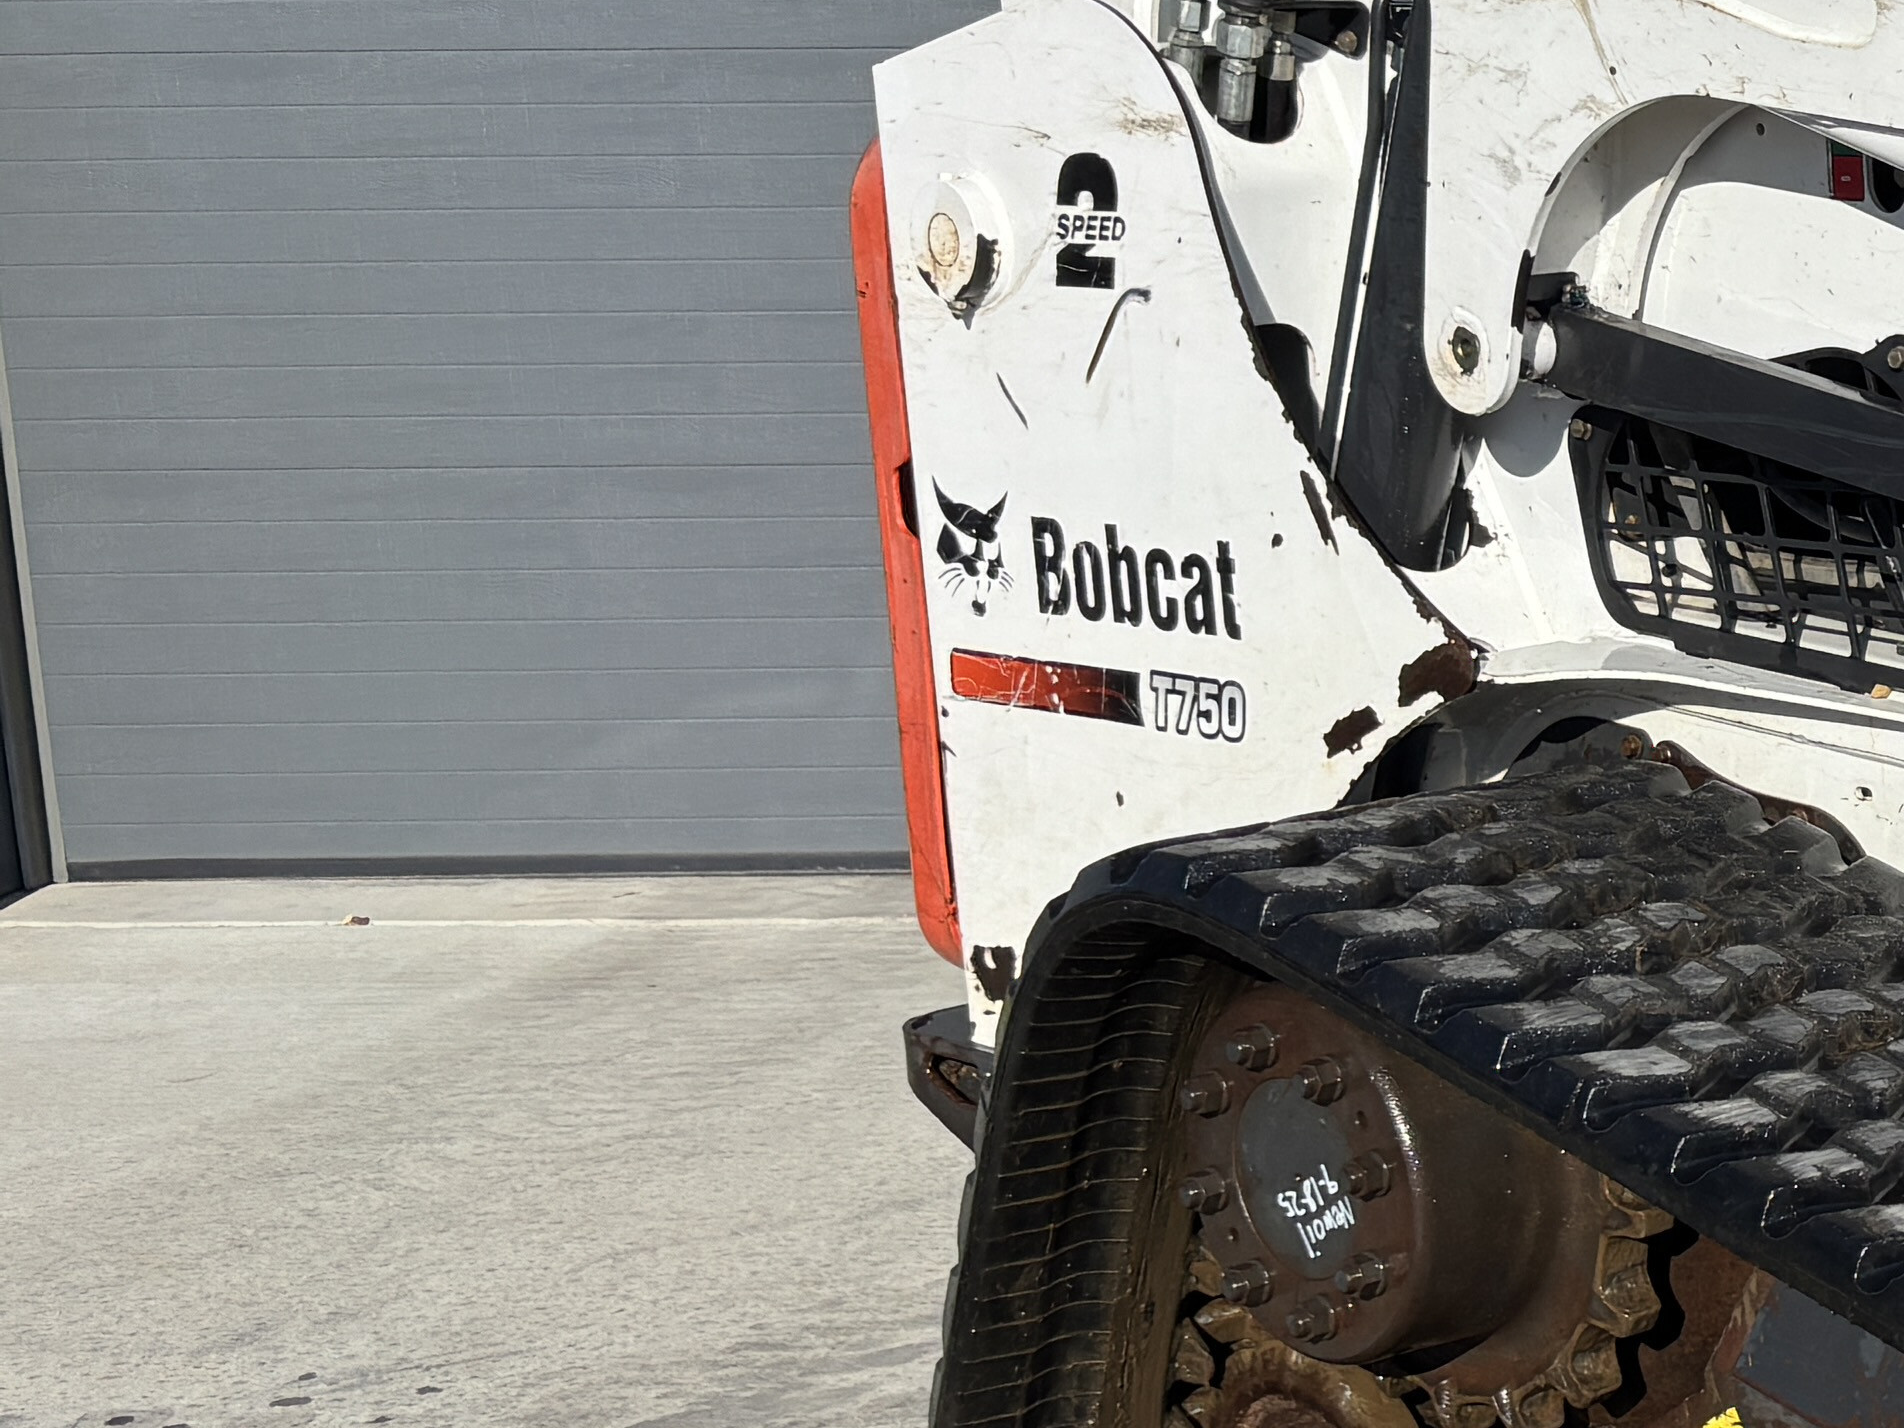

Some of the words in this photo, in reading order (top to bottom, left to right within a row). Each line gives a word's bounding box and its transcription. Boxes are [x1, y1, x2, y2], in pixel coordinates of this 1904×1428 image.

[1056, 152, 1118, 290] 2
[1056, 213, 1126, 242] SPEED
[1030, 515, 1243, 641] Bobcat
[1149, 669, 1246, 744] T750
